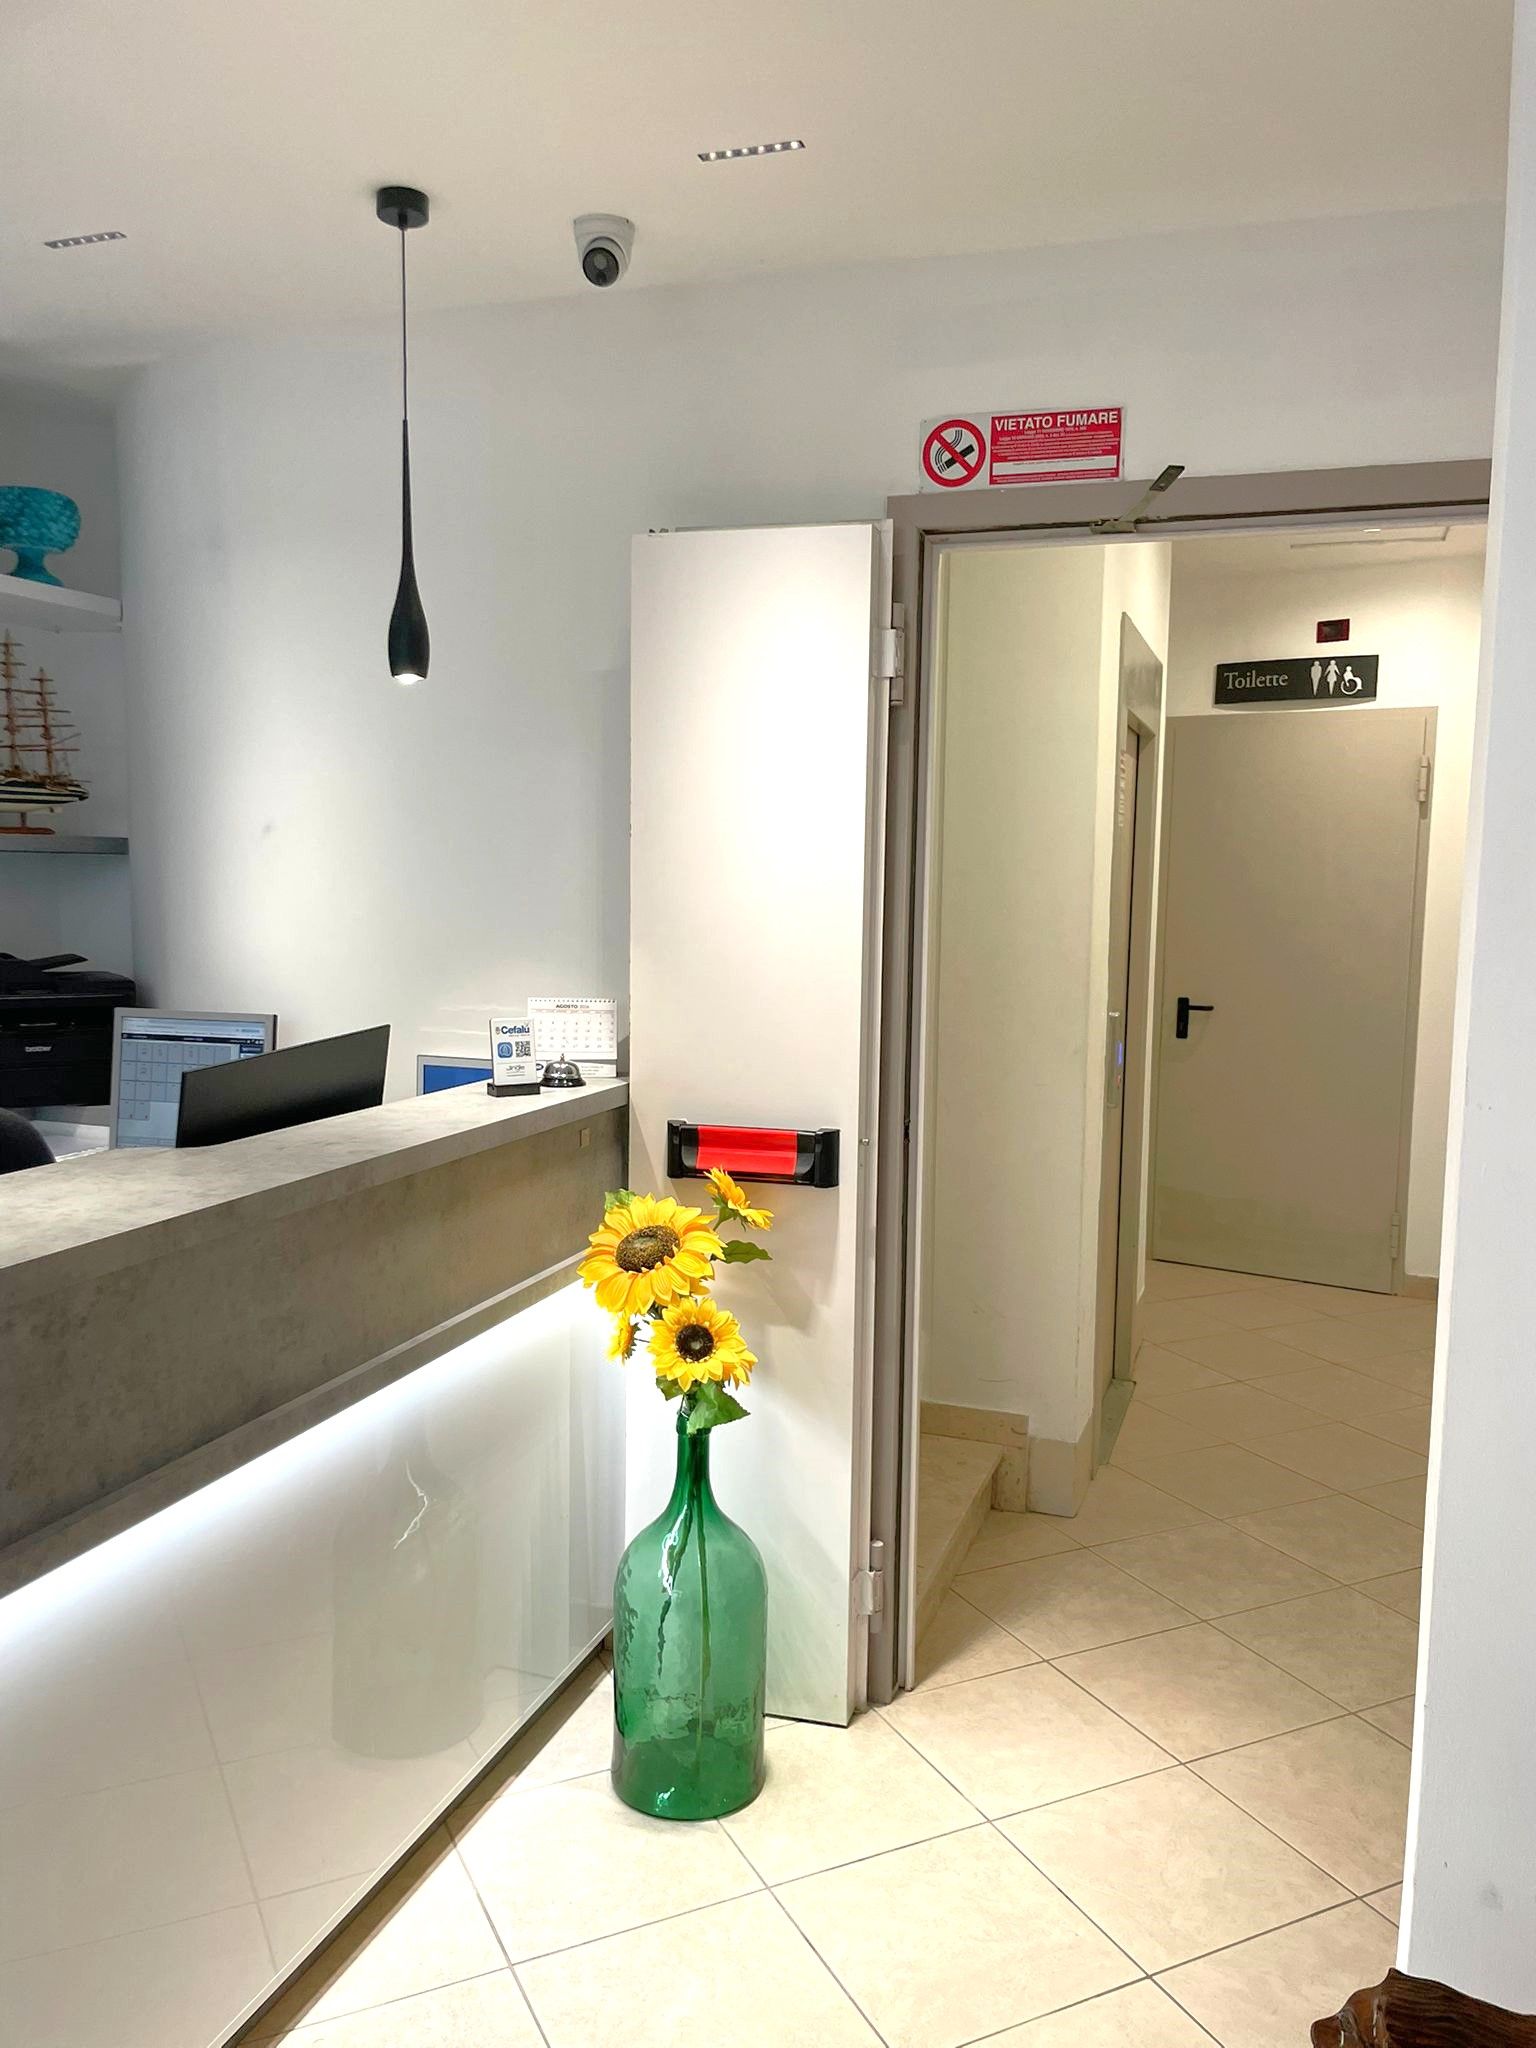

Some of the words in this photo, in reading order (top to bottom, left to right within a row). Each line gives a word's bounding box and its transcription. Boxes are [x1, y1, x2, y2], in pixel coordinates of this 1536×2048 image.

[995, 416, 1052, 431] VIETATO
[1057, 411, 1118, 427] FUMARE
[1224, 670, 1289, 690] Toilette
